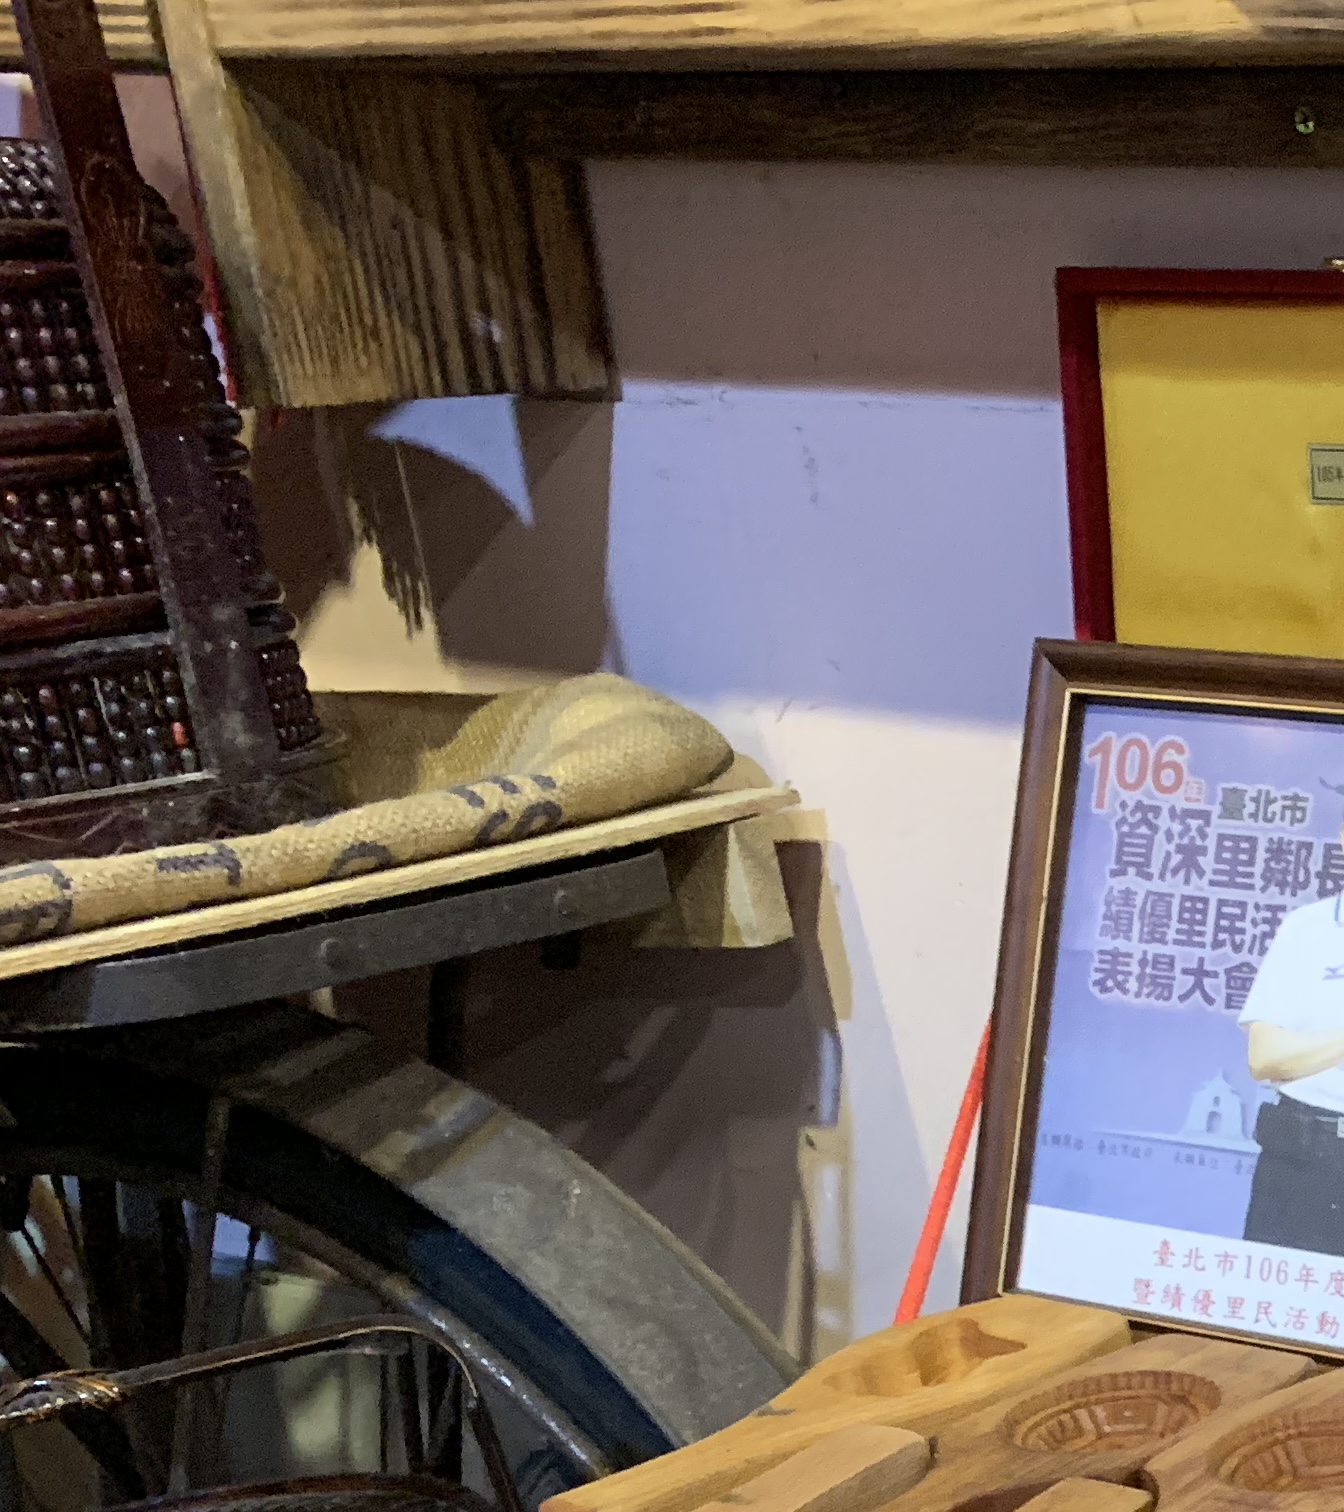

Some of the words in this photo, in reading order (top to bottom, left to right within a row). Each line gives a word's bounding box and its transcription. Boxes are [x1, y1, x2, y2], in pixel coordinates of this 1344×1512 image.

[1218, 786, 1309, 827] 臺北市
[1092, 946, 1258, 1010] 表揚大會
